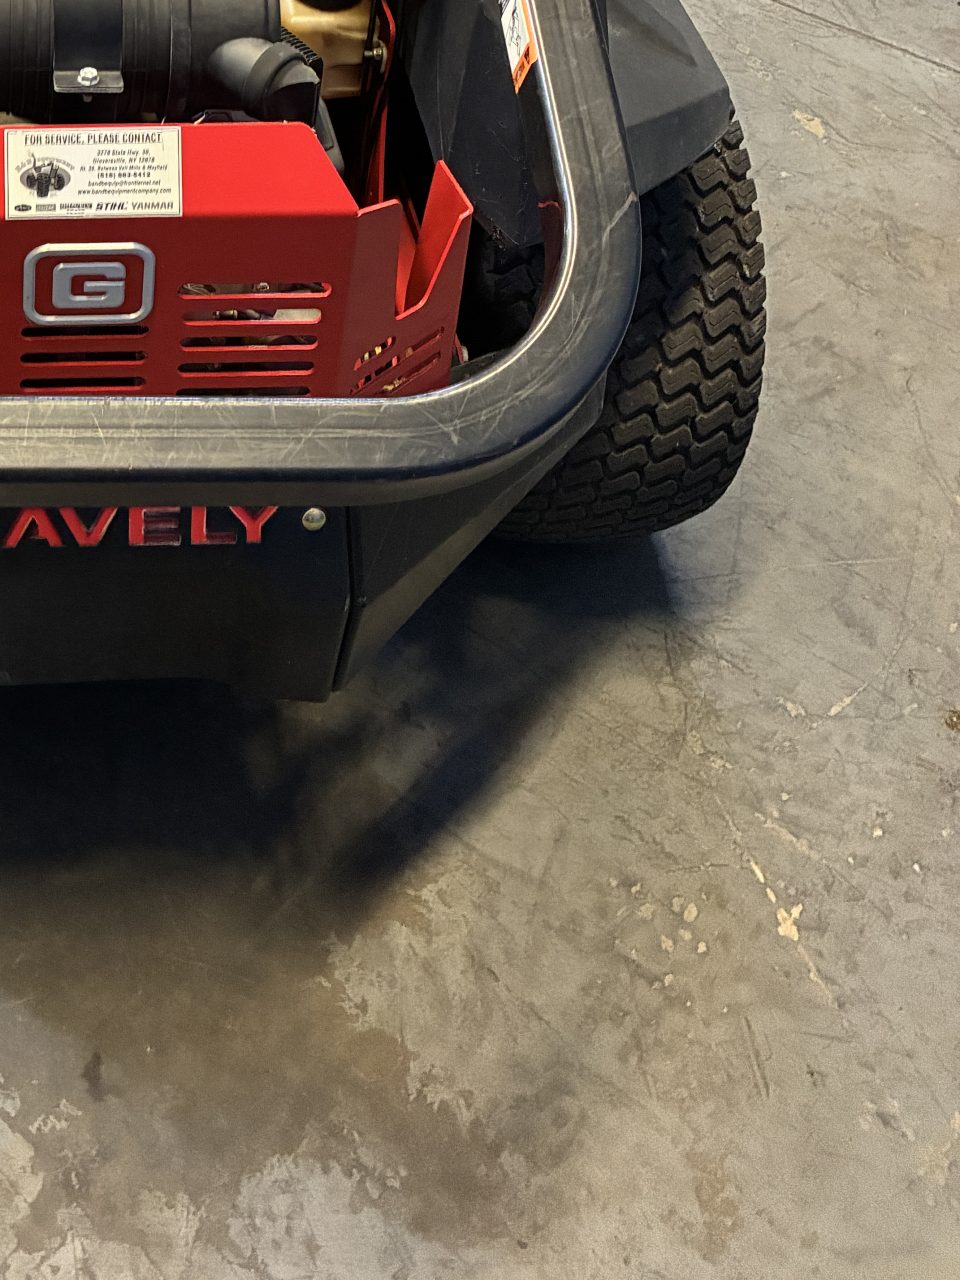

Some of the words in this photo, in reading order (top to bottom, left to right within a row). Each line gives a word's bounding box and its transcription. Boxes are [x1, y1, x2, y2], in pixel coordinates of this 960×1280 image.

[24, 133, 42, 145] FOR
[45, 133, 85, 145] SERVICE,
[87, 132, 120, 144] PLEASE
[122, 131, 161, 144] CONTACT
[128, 156, 137, 164] NY
[131, 201, 174, 211] YANMAR
[52, 261, 126, 309] G
